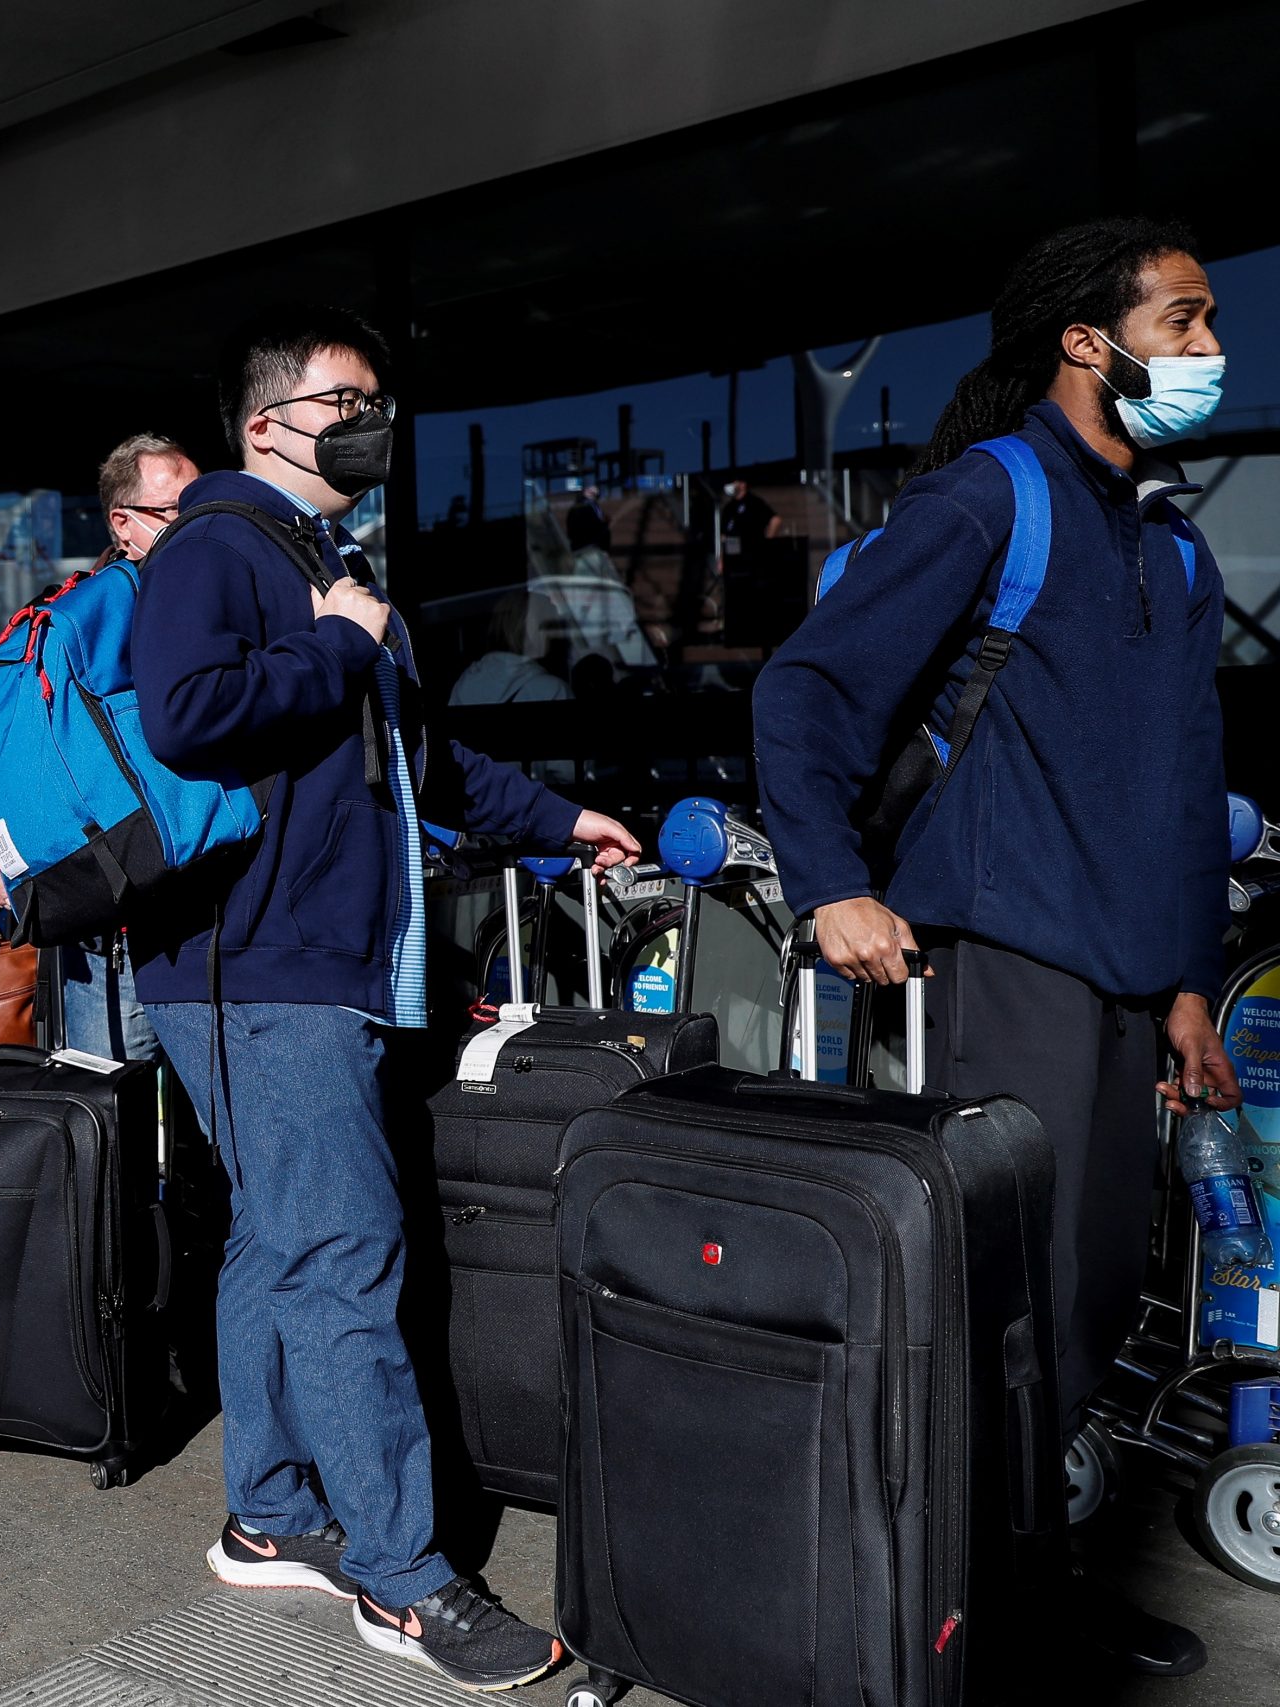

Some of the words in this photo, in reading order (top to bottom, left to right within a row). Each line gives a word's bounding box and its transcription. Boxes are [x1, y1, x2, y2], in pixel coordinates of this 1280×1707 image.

[634, 981, 642, 990] TO
[642, 983, 669, 992] FRIENDLY
[816, 983, 841, 993] ELCOME
[818, 993, 848, 1002] FRIENDLY
[1243, 1007, 1280, 1018] WELCOM
[1242, 1017, 1254, 1026] TO
[1255, 1018, 1280, 1029] FRIEN
[1231, 1027, 1262, 1046] Los
[1247, 1066, 1280, 1079] WORL
[463, 1084, 495, 1093] Samsonite
[1238, 1077, 1280, 1092] IRPORT
[1209, 1266, 1261, 1290] Star
